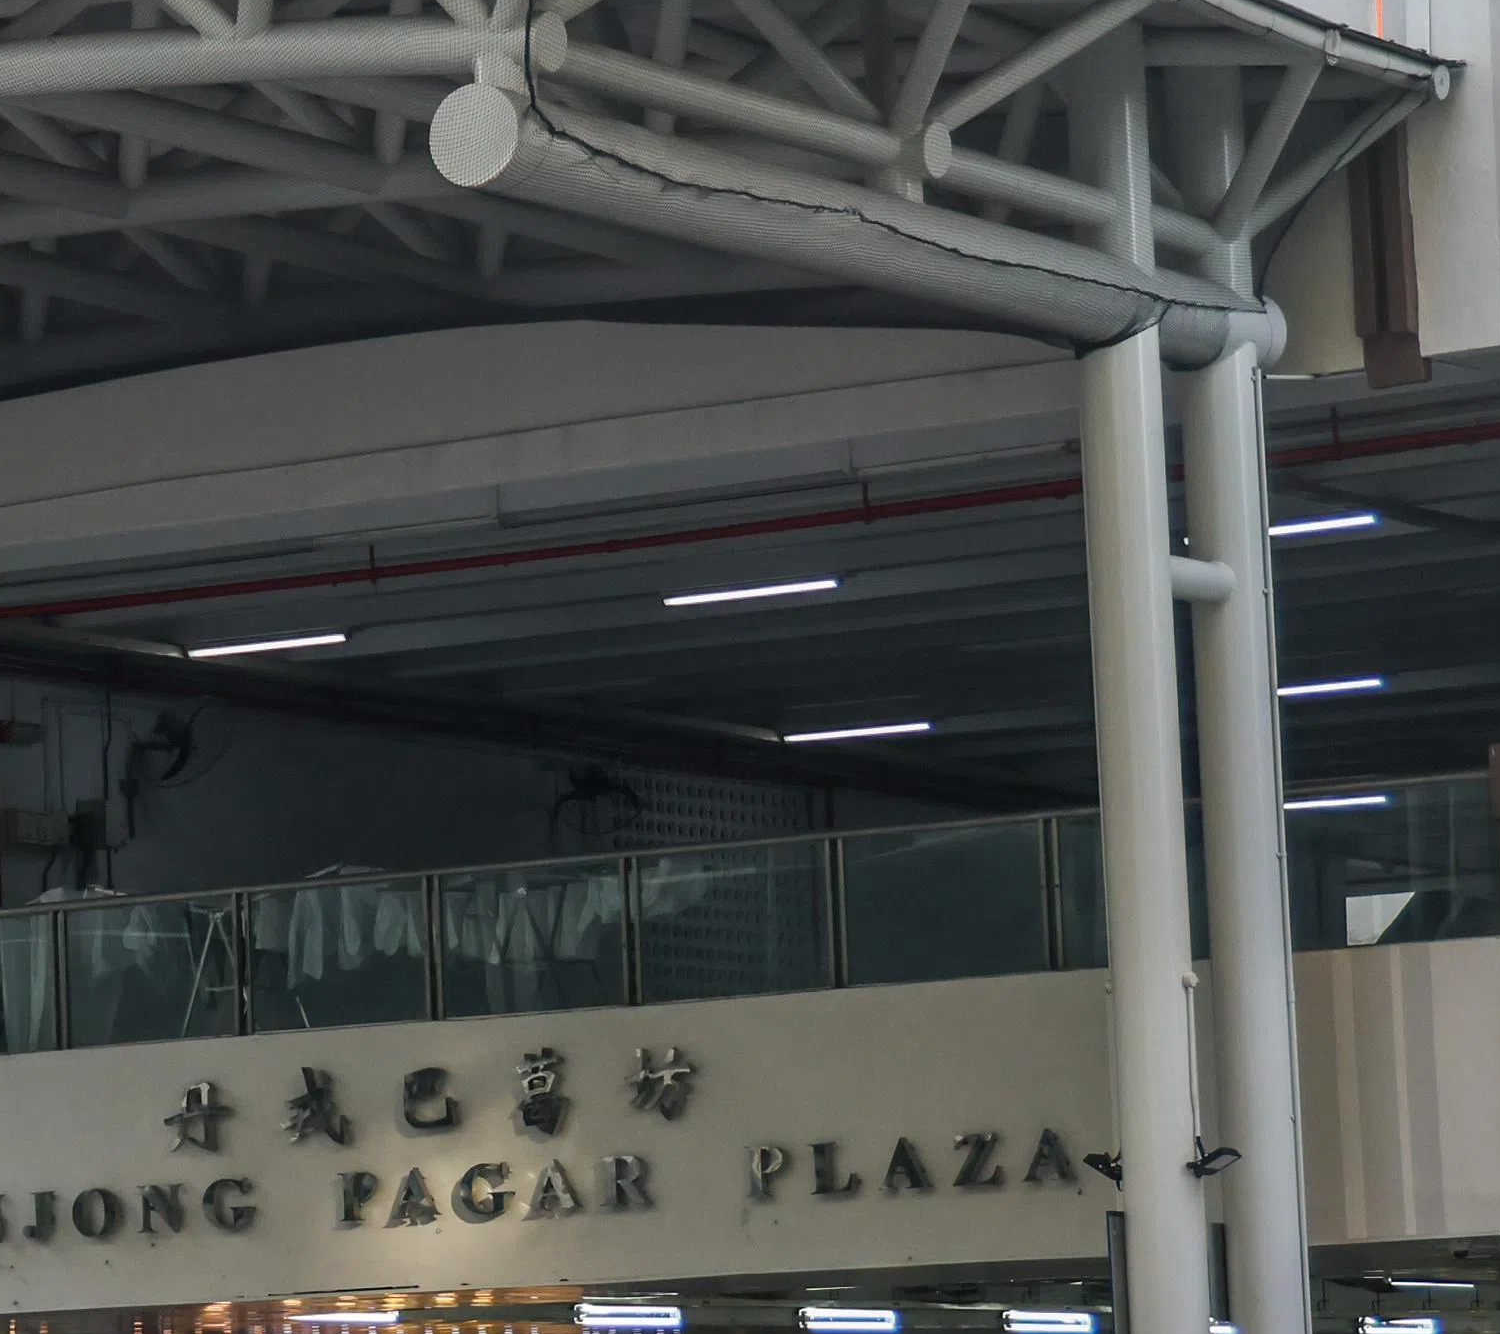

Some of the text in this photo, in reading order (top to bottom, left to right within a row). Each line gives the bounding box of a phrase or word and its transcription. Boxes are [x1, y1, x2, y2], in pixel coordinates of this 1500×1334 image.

[162, 1045, 700, 1153] 丹戎巴葛坊
[334, 1153, 658, 1229] PAGAR
[744, 1127, 1082, 1201] PLAZA
